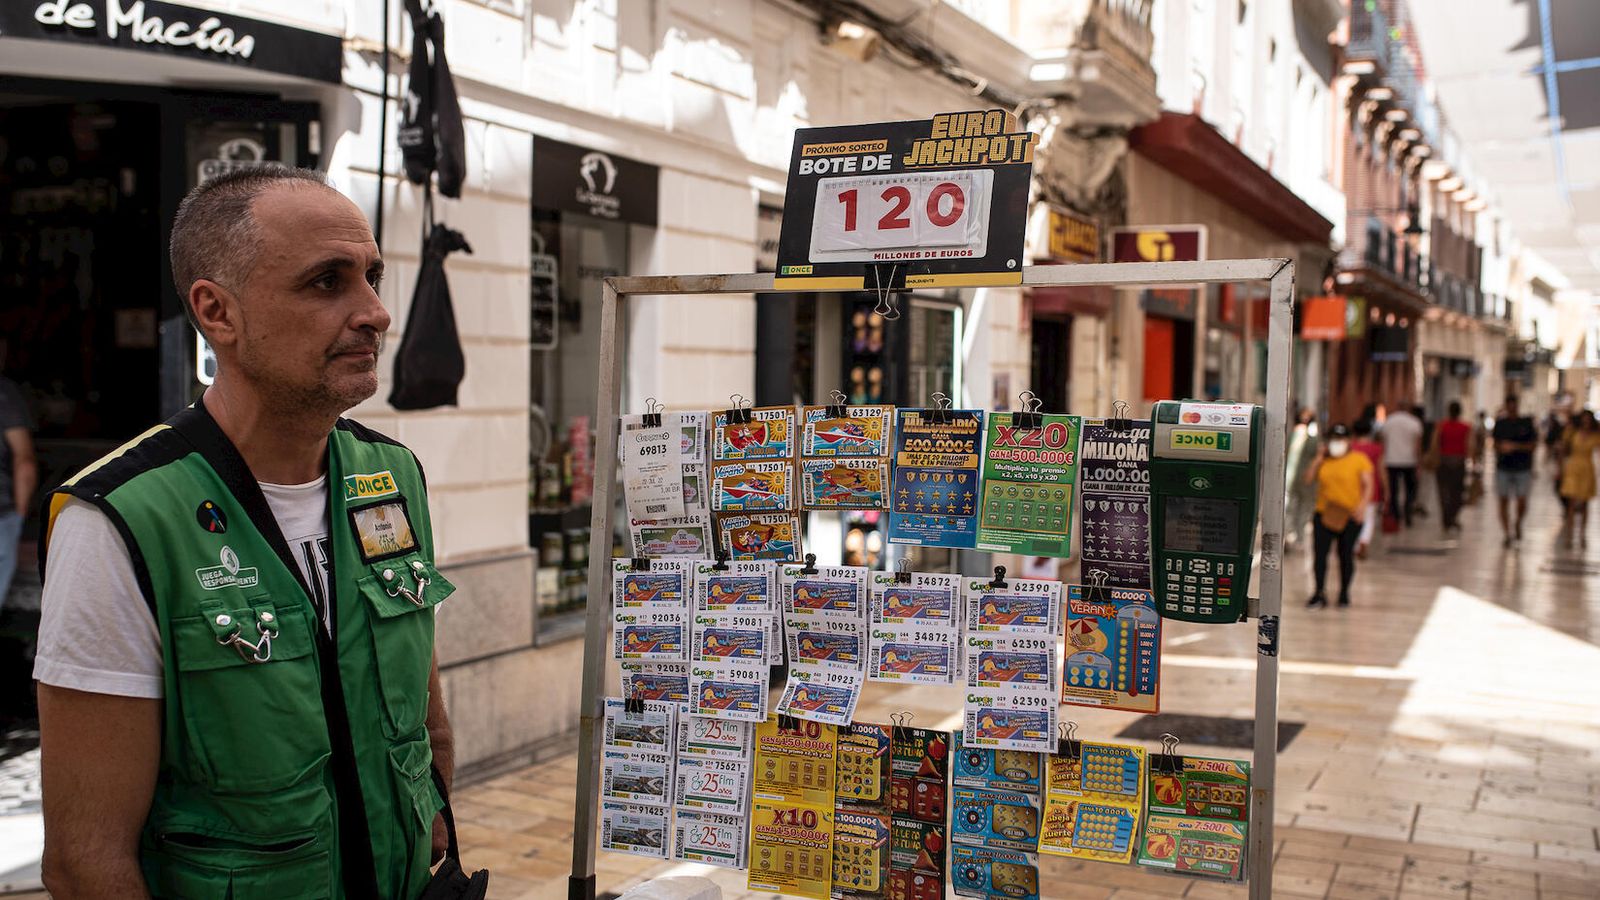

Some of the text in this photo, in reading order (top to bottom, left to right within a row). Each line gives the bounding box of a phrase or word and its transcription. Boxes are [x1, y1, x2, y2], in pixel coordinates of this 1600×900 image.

[35, 0, 256, 59] de Macías
[931, 110, 1005, 140] EURO
[805, 142, 885, 156] PRÓXIMO SORTEO
[903, 133, 1029, 167] JACKPOT
[798, 153, 893, 176] BOTE DE
[874, 251, 921, 260] MILLONES
[941, 249, 974, 258] EUROS
[790, 266, 812, 274] ONCE
[760, 411, 785, 421] 17501
[852, 408, 882, 419] 63129
[1175, 434, 1215, 446] ONCE
[639, 444, 668, 457] 69813
[904, 439, 975, 454] 500.000€
[1083, 441, 1150, 462] MILLONA
[941, 453, 971, 462] MILLONES
[989, 449, 1075, 465] GANA 500.000€
[715, 462, 784, 479] Verano 17501
[802, 459, 878, 473] Verano 63129
[994, 463, 1030, 473] Multiplica
[1040, 467, 1066, 475] premio
[1116, 461, 1139, 469] GANA
[357, 476, 393, 494] ONCE
[672, 515, 700, 526] 97268
[763, 514, 789, 525] 17501
[652, 561, 681, 571] 92036
[737, 563, 767, 573] 59081
[202, 570, 224, 581] JUEGA
[826, 568, 857, 579] 10923
[917, 576, 950, 587] 34872
[1015, 582, 1050, 593] 62390
[652, 614, 681, 623] 92036
[732, 616, 763, 627] 59081
[826, 620, 857, 632] 10923
[915, 631, 948, 642] 34872
[1011, 638, 1047, 650] 62390
[657, 663, 686, 673] 92036
[729, 669, 760, 679] 59081
[827, 672, 854, 685] 10923
[1012, 695, 1048, 707] 62390
[705, 719, 723, 740] 25
[781, 738, 833, 752] 150.000€
[1099, 747, 1131, 757] 10.000€
[640, 753, 666, 765] 91425
[715, 761, 741, 772] 75621
[1197, 760, 1231, 773] 7.500€
[702, 773, 720, 793] 25
[1052, 771, 1080, 783] suerte
[638, 805, 664, 817] 91425
[1096, 806, 1127, 817] 10.000€
[1210, 805, 1233, 814] PREMIO
[713, 814, 739, 826] 75621
[840, 814, 877, 827] 100.000€
[1047, 815, 1071, 825] abeja
[1194, 820, 1228, 833] 7.500€
[700, 825, 718, 846] 25
[755, 825, 830, 843] GANA 150.000€
[1044, 830, 1073, 841] suerte
[1200, 861, 1224, 872] PREMIO
